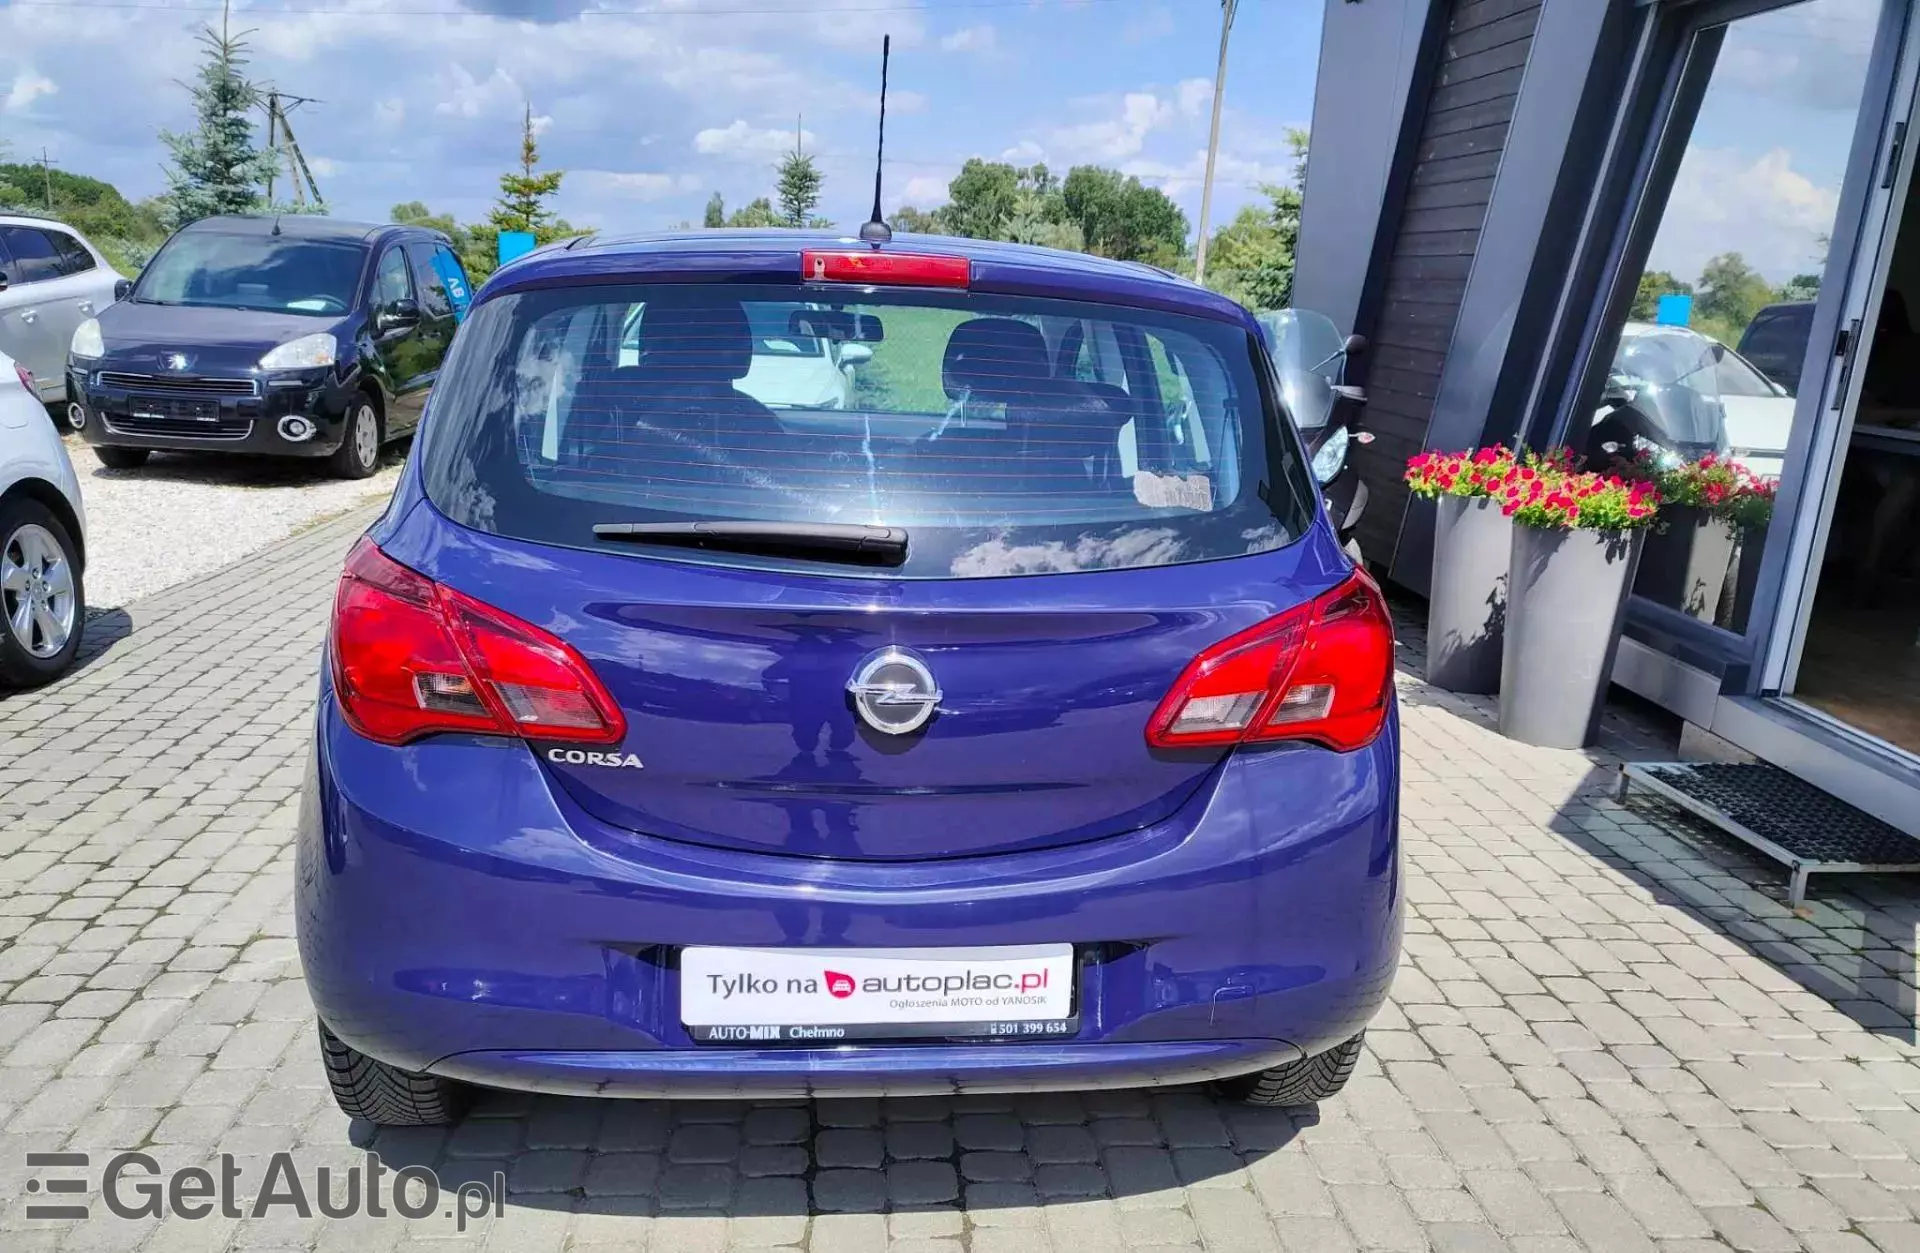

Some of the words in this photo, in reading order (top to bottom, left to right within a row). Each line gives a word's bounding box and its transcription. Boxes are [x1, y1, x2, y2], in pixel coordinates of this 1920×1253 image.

[548, 748, 644, 769] CORSA
[706, 973, 778, 999] Tylko
[787, 979, 818, 994] na
[862, 968, 1048, 996] autoplac.pl
[889, 998, 949, 1009] Ogłoszenia
[950, 997, 983, 1007] MOTO
[985, 996, 999, 1006] od
[1002, 995, 1047, 1006] YANOSIK
[999, 1023, 1019, 1034] 501
[1023, 1023, 1043, 1034] 399
[1046, 1022, 1067, 1033] 654
